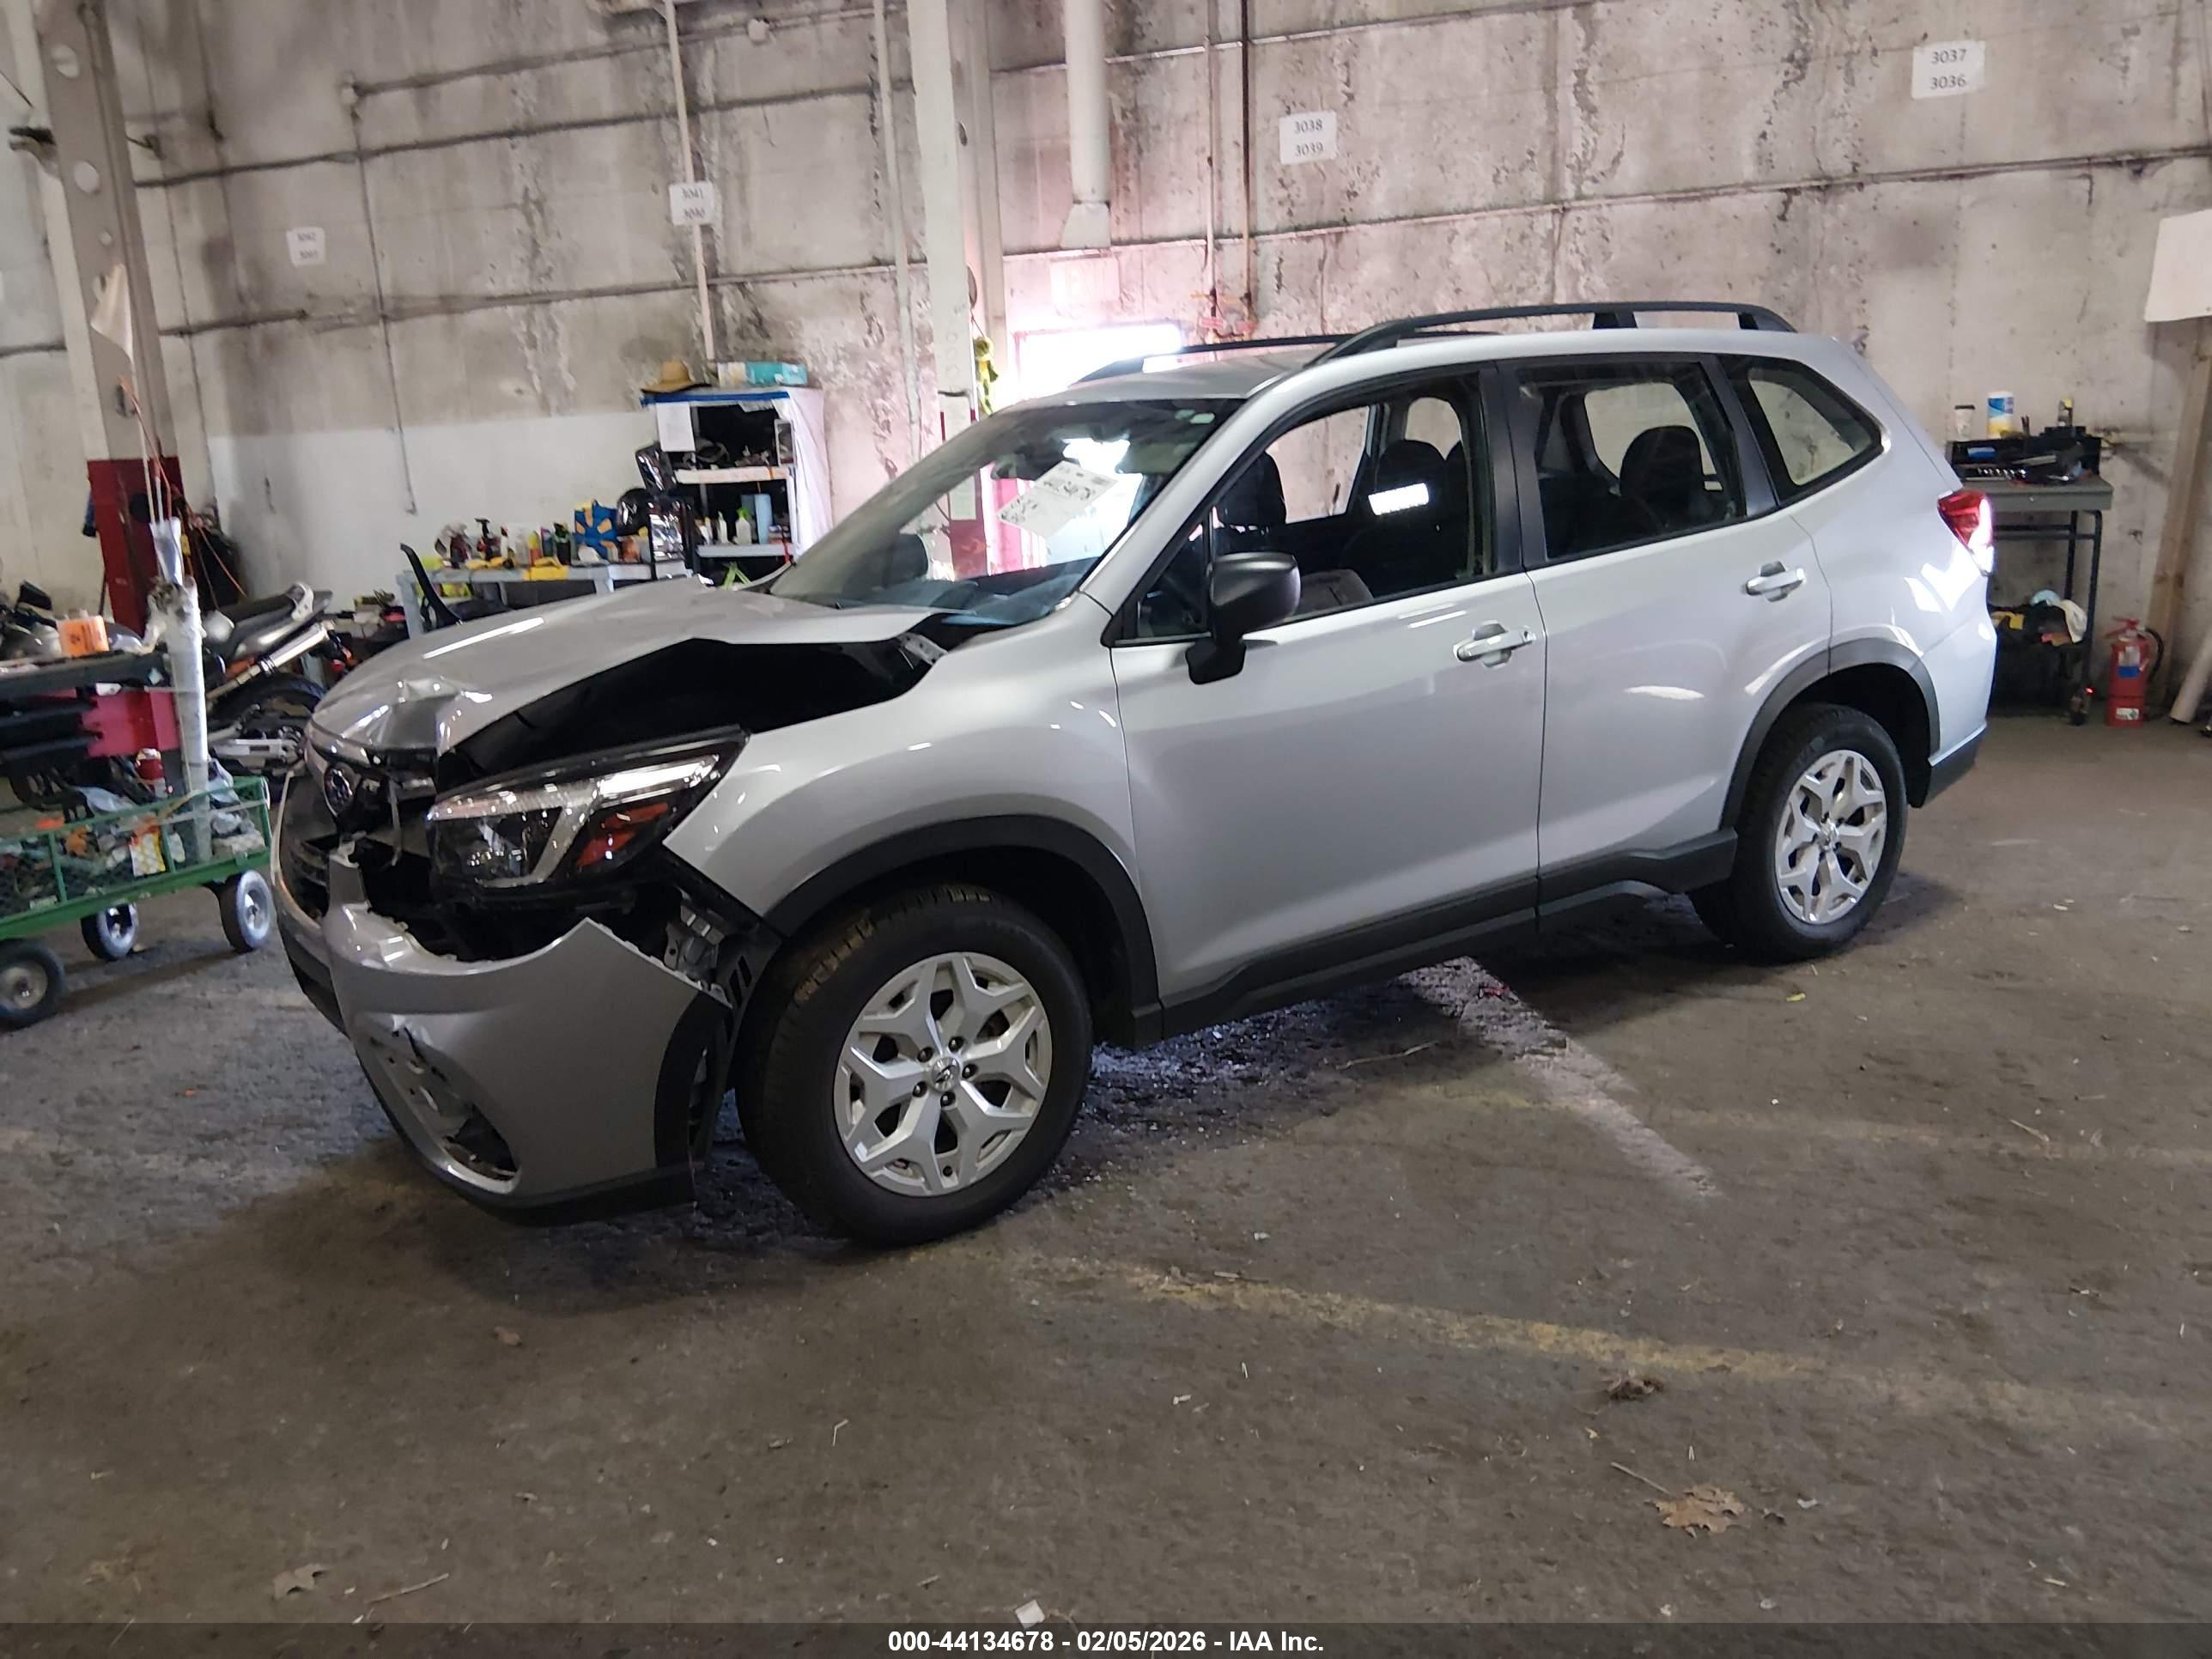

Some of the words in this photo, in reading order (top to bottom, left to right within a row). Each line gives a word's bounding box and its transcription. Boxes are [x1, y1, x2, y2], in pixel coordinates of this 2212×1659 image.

[1930, 48, 1966, 64] 3037
[1930, 74, 1966, 89] 3036
[1294, 118, 1323, 134] 3038
[1294, 142, 1324, 157] 3039
